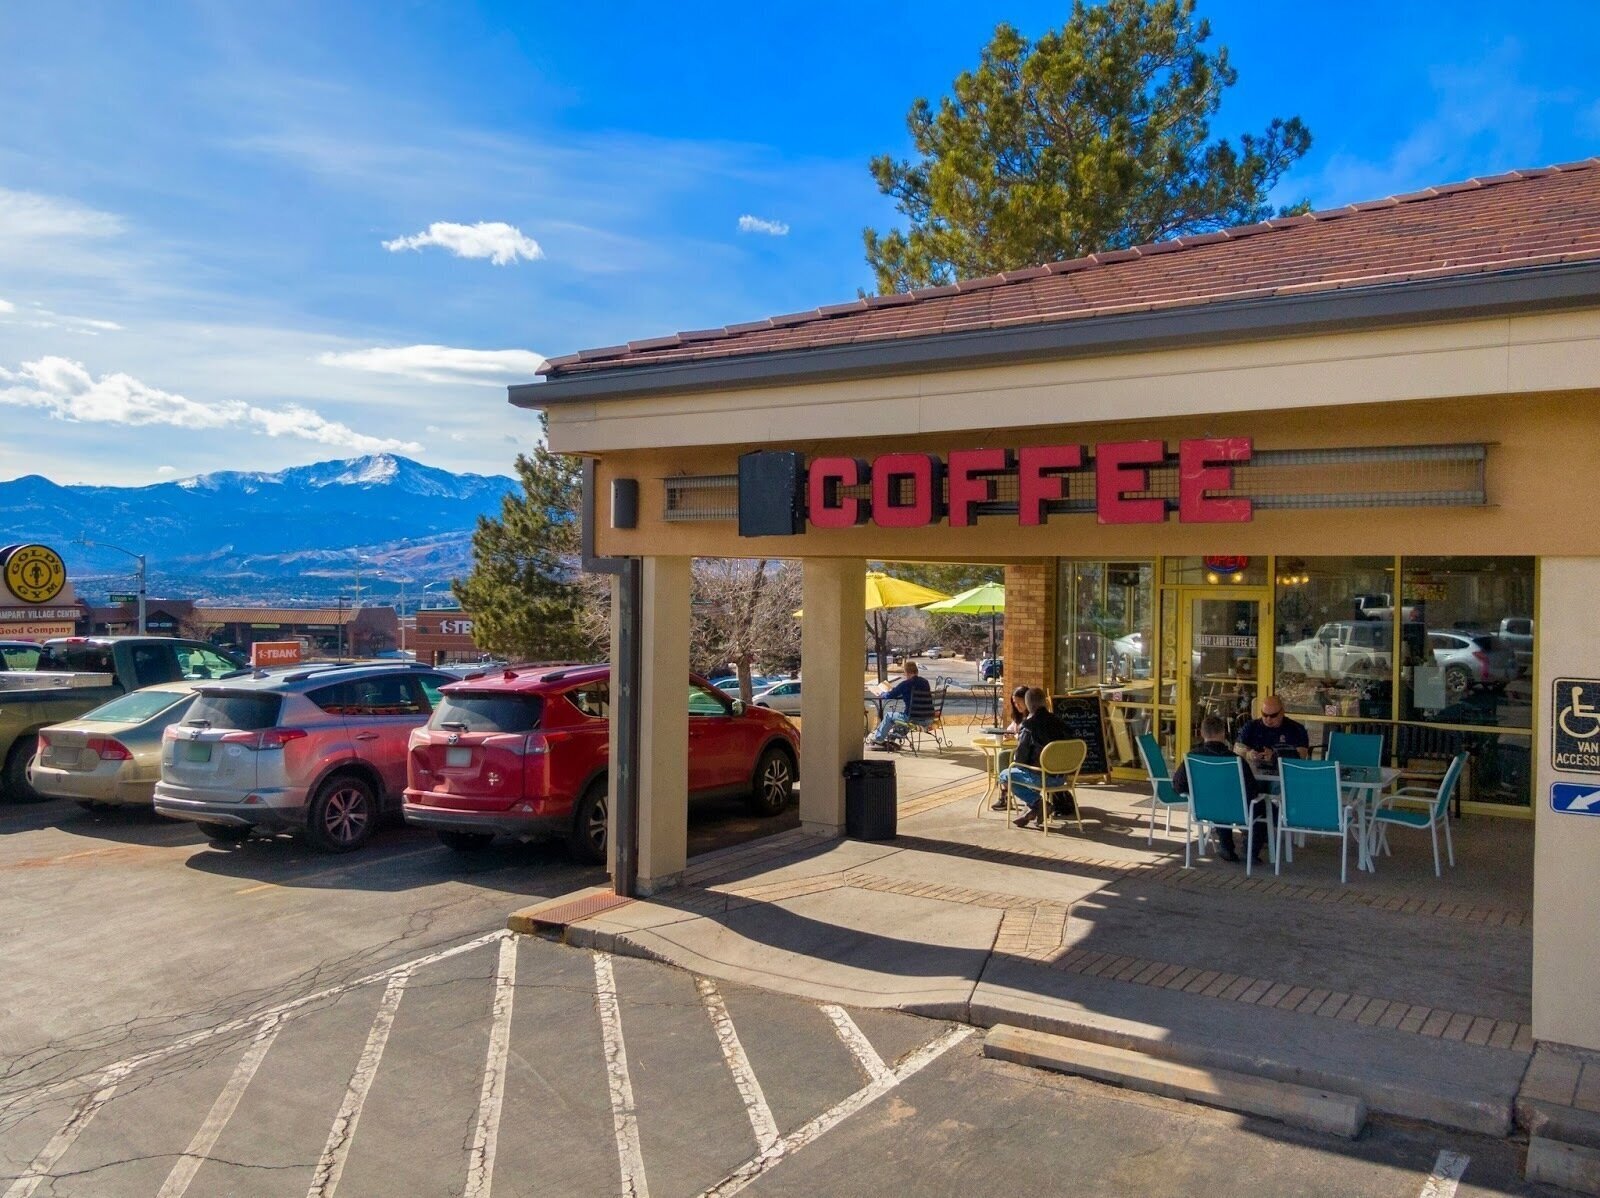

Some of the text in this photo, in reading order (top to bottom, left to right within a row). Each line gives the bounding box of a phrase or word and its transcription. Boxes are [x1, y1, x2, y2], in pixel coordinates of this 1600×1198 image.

[809, 437, 1252, 528] COFFEE
[12, 549, 60, 574] GOLD'S
[17, 583, 58, 599] GYM
[28, 610, 55, 619] VILLAGE
[56, 609, 80, 618] CENTER
[27, 626, 71, 634] Company
[1577, 741, 1599, 753] VAN
